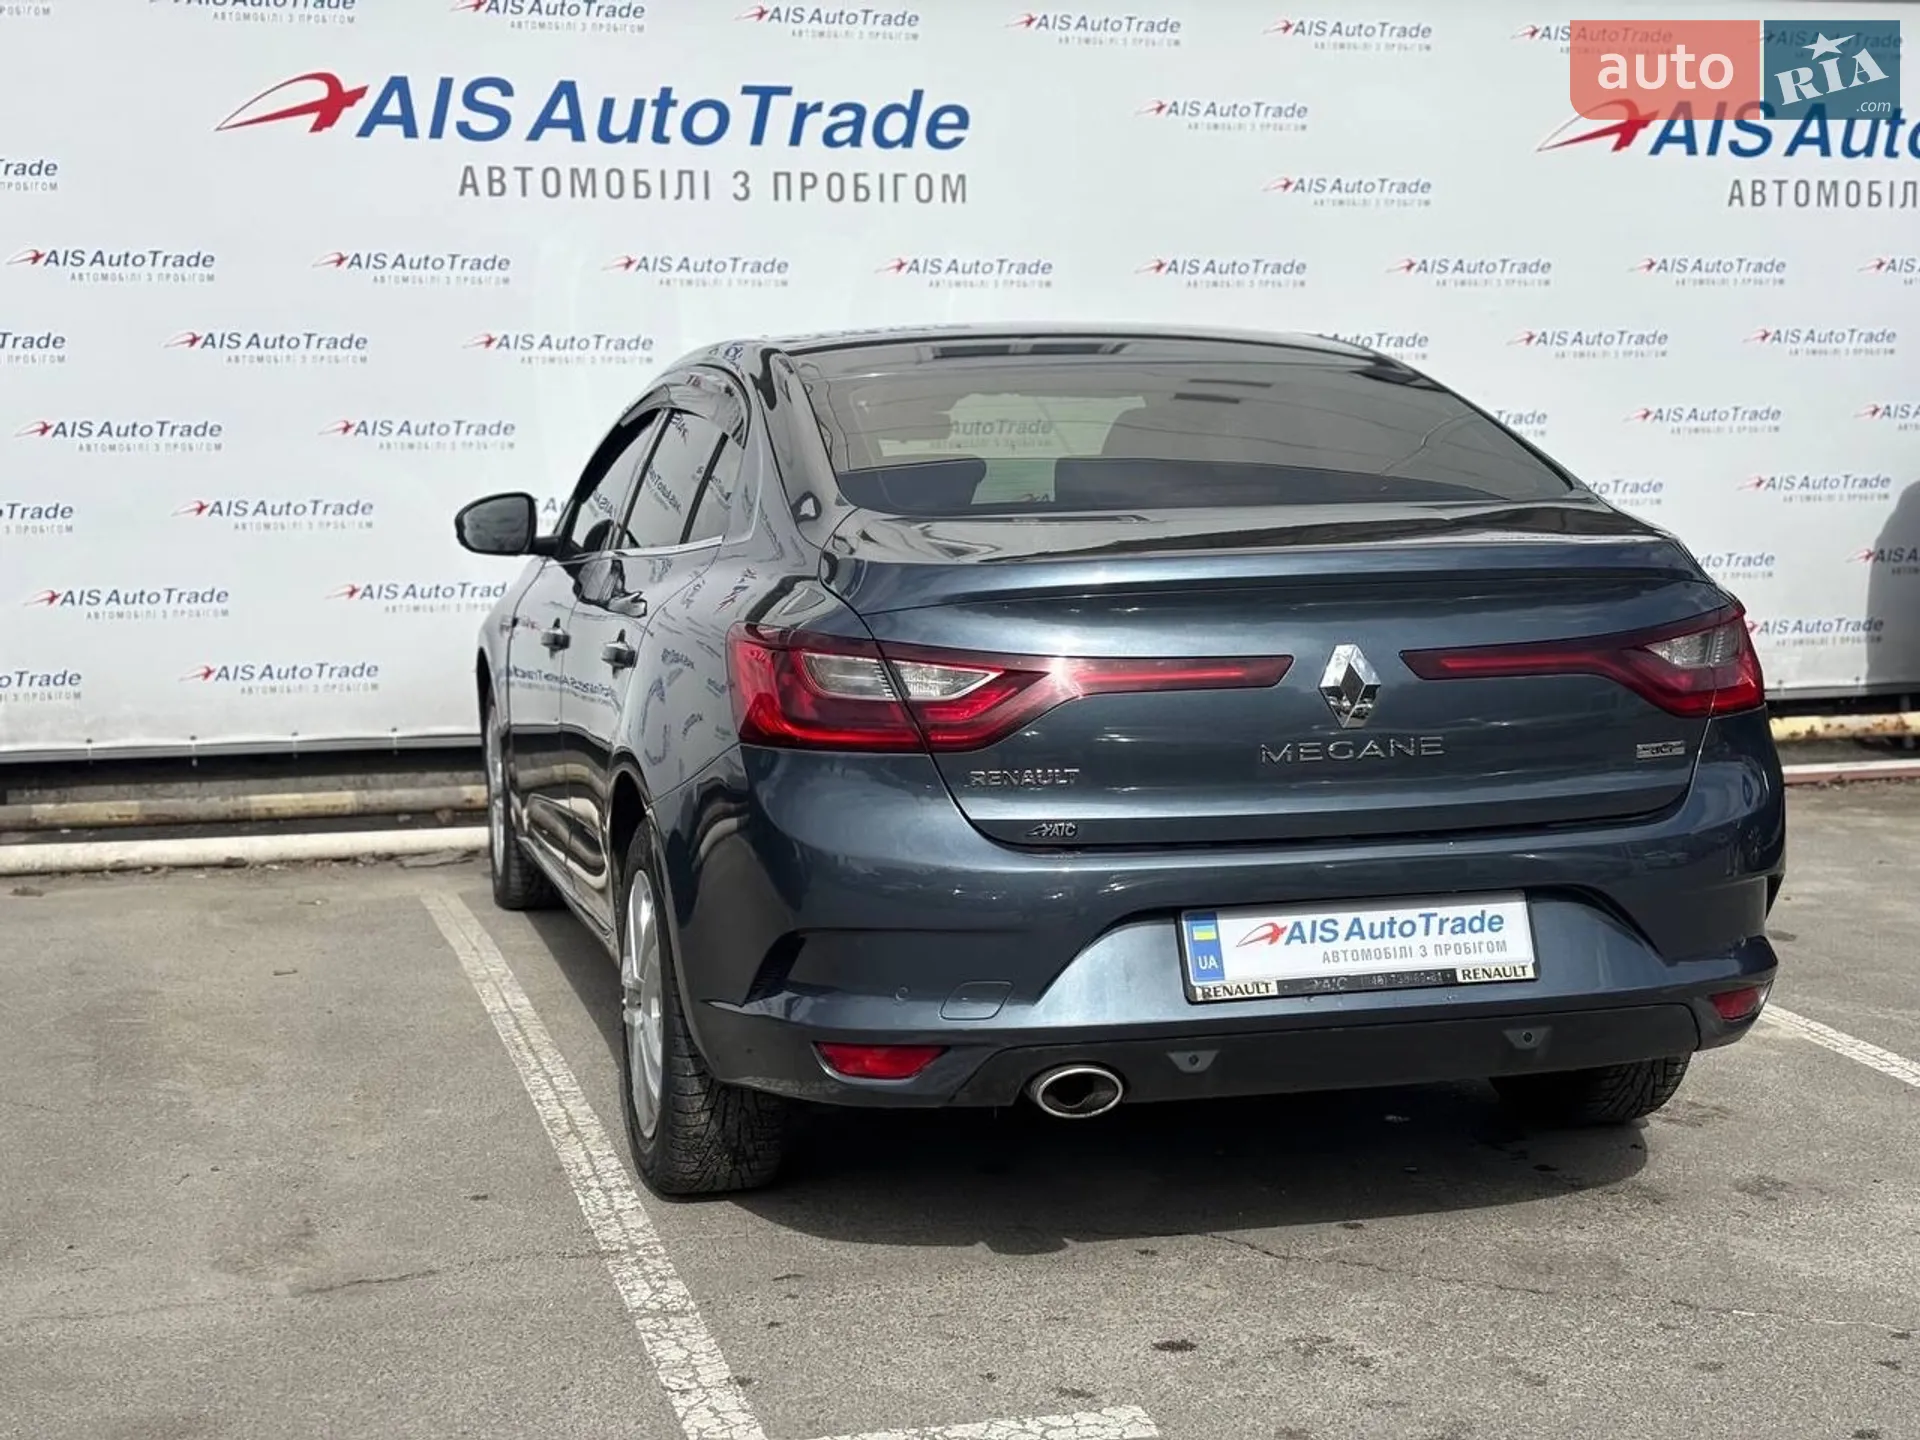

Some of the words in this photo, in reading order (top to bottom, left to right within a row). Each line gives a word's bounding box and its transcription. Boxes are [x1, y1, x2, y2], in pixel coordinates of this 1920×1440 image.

[486, 0, 525, 15] AIS
[527, 0, 645, 19] AutoTrade
[768, 6, 805, 27] AIS
[807, 8, 920, 27] AutoTrade
[1035, 14, 1072, 31] AIS
[1074, 15, 1181, 33] AutoTrade
[1295, 20, 1328, 37] AIS
[1329, 21, 1432, 38] AutoTrade
[356, 76, 514, 141] AIS
[526, 80, 970, 150] AutoTrade
[1166, 100, 1201, 117] AIS
[1203, 101, 1308, 119] AutoTrade
[1648, 101, 1774, 158] AIS
[458, 165, 711, 201] АВТОМОБІЛІ
[732, 170, 751, 202] З
[772, 170, 967, 204] ПРОБІГОМ
[1293, 177, 1327, 194] AIS
[1329, 178, 1432, 194] AutoTrade
[43, 249, 86, 267] AIS
[88, 250, 215, 268] AutoTrade
[348, 252, 388, 270] AIS
[390, 253, 511, 271] AutoTrade
[635, 255, 673, 273] AIS
[676, 256, 789, 274] AutoTrade
[907, 258, 943, 275] AIS
[944, 258, 1053, 275] AutoTrade
[1167, 259, 1200, 275] AIS
[1202, 259, 1307, 275] AutoTrade
[1416, 258, 1450, 275] AIS
[1451, 258, 1552, 274] AutoTrade
[1656, 258, 1688, 274] AIS
[1690, 258, 1786, 273] AutoTrade
[200, 332, 242, 350] AIS
[245, 332, 368, 350] AutoTrade
[496, 333, 535, 351] AIS
[537, 334, 654, 351] AutoTrade
[1537, 331, 1569, 346] AIS
[1570, 330, 1668, 346] AutoTrade
[1770, 328, 1802, 344] AIS
[1804, 328, 1897, 344] AutoTrade
[1652, 407, 1684, 423] AIS
[1685, 406, 1782, 422] AutoTrade
[52, 420, 94, 438] AIS
[96, 420, 222, 438] AutoTrade
[353, 420, 394, 437] AIS
[396, 420, 516, 437] AutoTrade
[1768, 475, 1796, 491] AIS
[1798, 474, 1891, 490] AutoTrade
[208, 500, 249, 517] AIS
[252, 499, 374, 516] AutoTrade
[60, 589, 101, 607] AIS
[105, 586, 229, 606] AutoTrade
[361, 583, 399, 600] AIS
[1758, 620, 1789, 634] AIS
[1791, 617, 1884, 634] AutoTrade
[215, 664, 255, 682] AIS
[258, 662, 379, 681] AutoTrade
[1260, 736, 1446, 764] MEGANE
[969, 768, 1079, 787] RENAULT
[1285, 919, 1340, 946] AIS
[1344, 910, 1505, 942] AutoTrade
[1434, 940, 1508, 957] ПРОБІГОМ
[1198, 955, 1219, 970] UA
[1462, 965, 1529, 981] RENAULT
[1201, 982, 1272, 999] RENAULT
